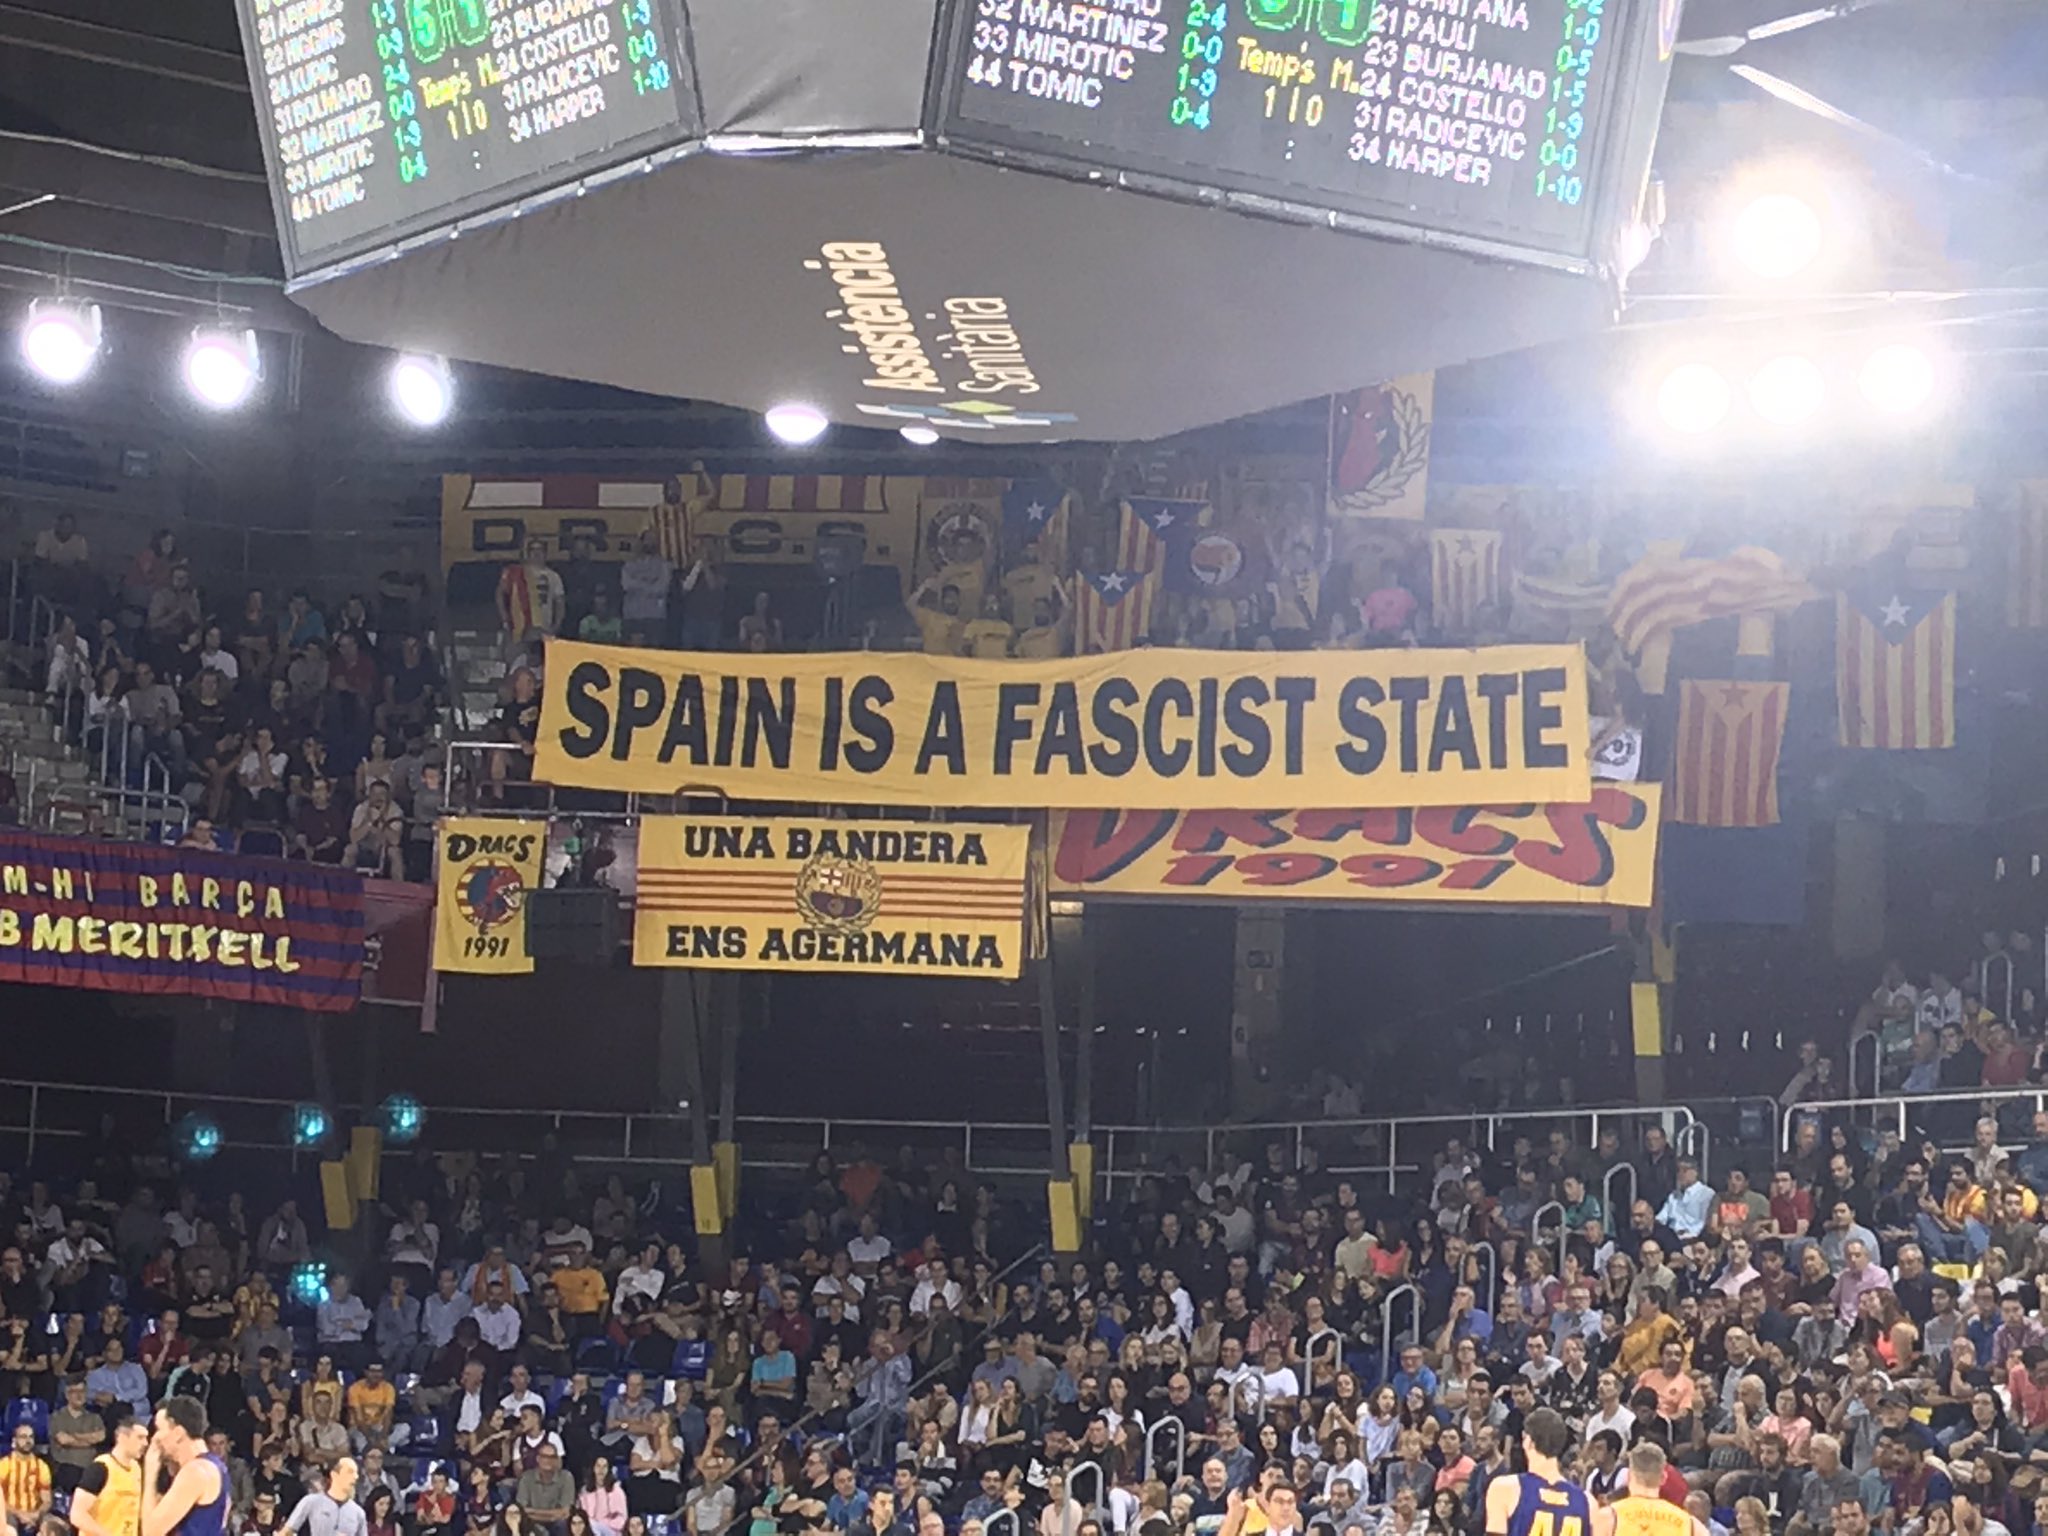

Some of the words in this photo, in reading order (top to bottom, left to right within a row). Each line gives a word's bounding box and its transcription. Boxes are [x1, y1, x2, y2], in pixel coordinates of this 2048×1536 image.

[490, 16, 513, 48] 23
[521, 12, 610, 70] COSTELLO
[628, 29, 657, 63] 0-0
[973, 20, 1009, 54] 33
[1014, 28, 1135, 81] MIROTIC
[1018, 0, 1168, 53] MARTINEZ
[1182, 31, 1222, 64] 0-0
[1368, 4, 1399, 35] 21
[1402, 10, 1477, 51] PAULI
[1556, 45, 1594, 76] 0-5
[1563, 13, 1600, 45] 1-0
[967, 54, 1002, 87] 44
[1008, 60, 1103, 108] TOMIC
[1171, 97, 1209, 130] 0-4
[1359, 68, 1391, 100] 24
[1398, 77, 1526, 128] COSTELLO
[1364, 36, 1398, 67] 23
[1552, 76, 1587, 108] 1-5
[532, 84, 606, 134] HARPER
[1354, 100, 1382, 131] 31
[1385, 106, 1527, 160] RADICEVIC
[1540, 139, 1577, 171] 0-0
[1348, 132, 1381, 164] 34
[1385, 139, 1491, 186] HARPER
[1536, 170, 1582, 205] 1-10
[804, 242, 945, 393] Assistència
[559, 661, 795, 769] SPAIN
[820, 675, 894, 773] IS
[914, 681, 967, 775] A
[993, 677, 1316, 777] FASCIST
[1335, 668, 1568, 775] STATE
[446, 833, 536, 862] DRACS
[684, 825, 775, 859] UNA
[786, 827, 989, 866] BANDERA
[1160, 852, 1517, 890] 1991
[139, 871, 285, 918] BARÇA
[32, 913, 300, 973] MERITXELL
[463, 936, 510, 958] 1991
[665, 925, 748, 959] ENS
[758, 927, 1003, 969] AGERMANA
